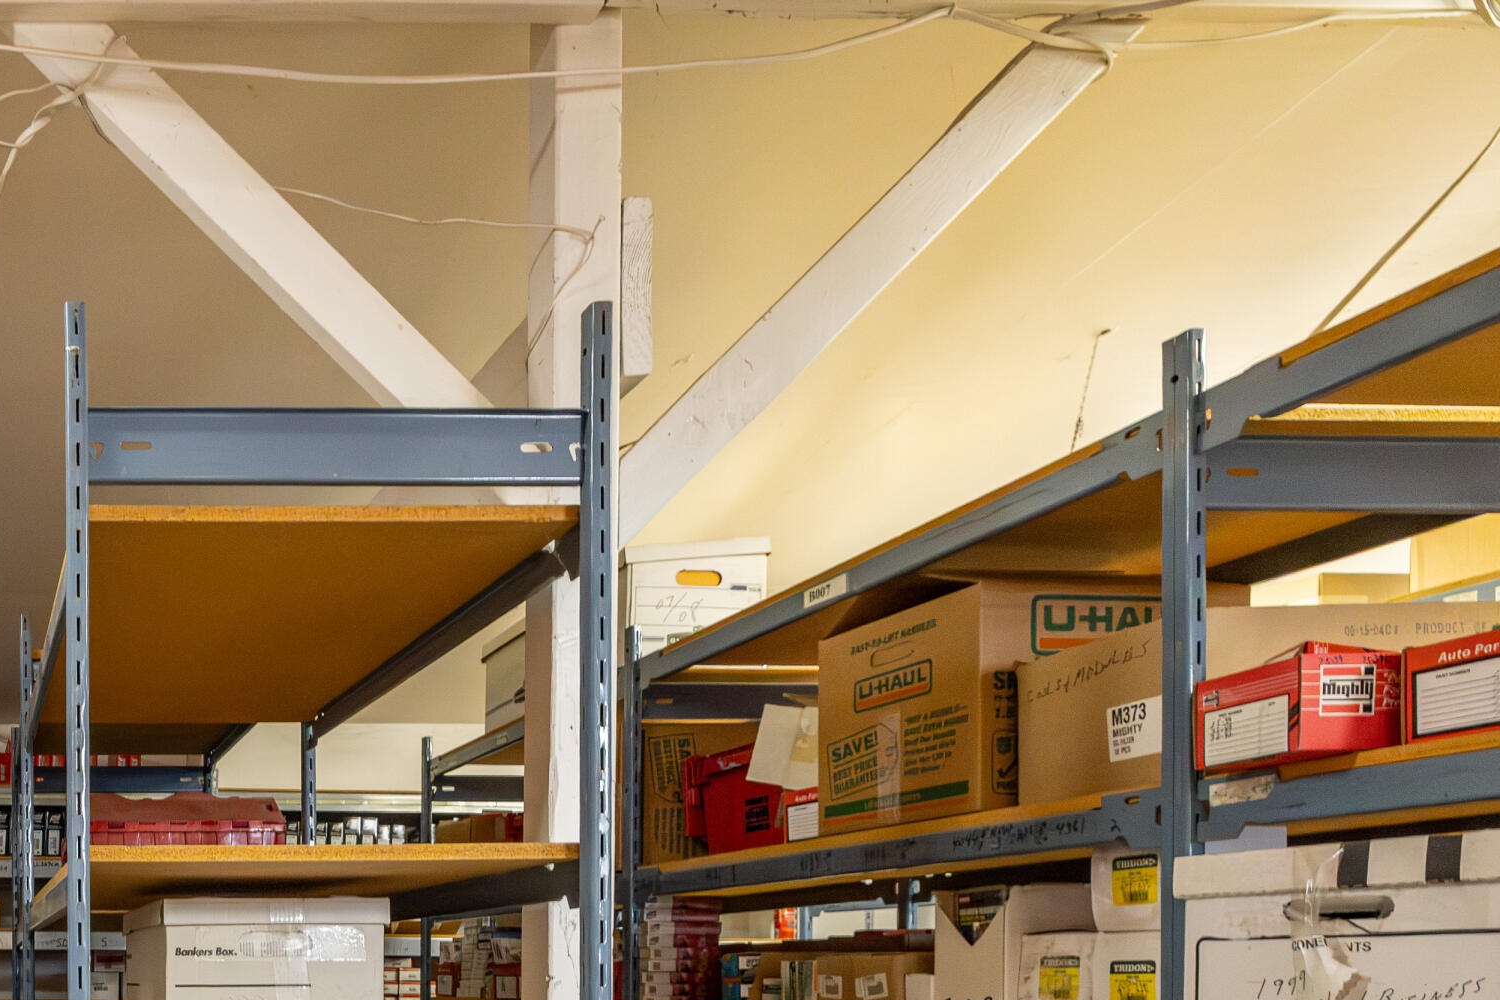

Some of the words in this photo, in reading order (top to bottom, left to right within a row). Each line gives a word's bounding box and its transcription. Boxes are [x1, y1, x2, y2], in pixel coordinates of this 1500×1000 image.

[1437, 648, 1471, 663] Auto
[1474, 641, 1500, 656] Par
[858, 666, 927, 700] U-HAUL
[1321, 680, 1374, 698] Mighty
[1111, 702, 1147, 727] M373
[1112, 723, 1143, 738] MIGHTY
[831, 730, 878, 763] SAVE!
[175, 946, 214, 957] Bankers
[1113, 963, 1147, 973] TRIDON
